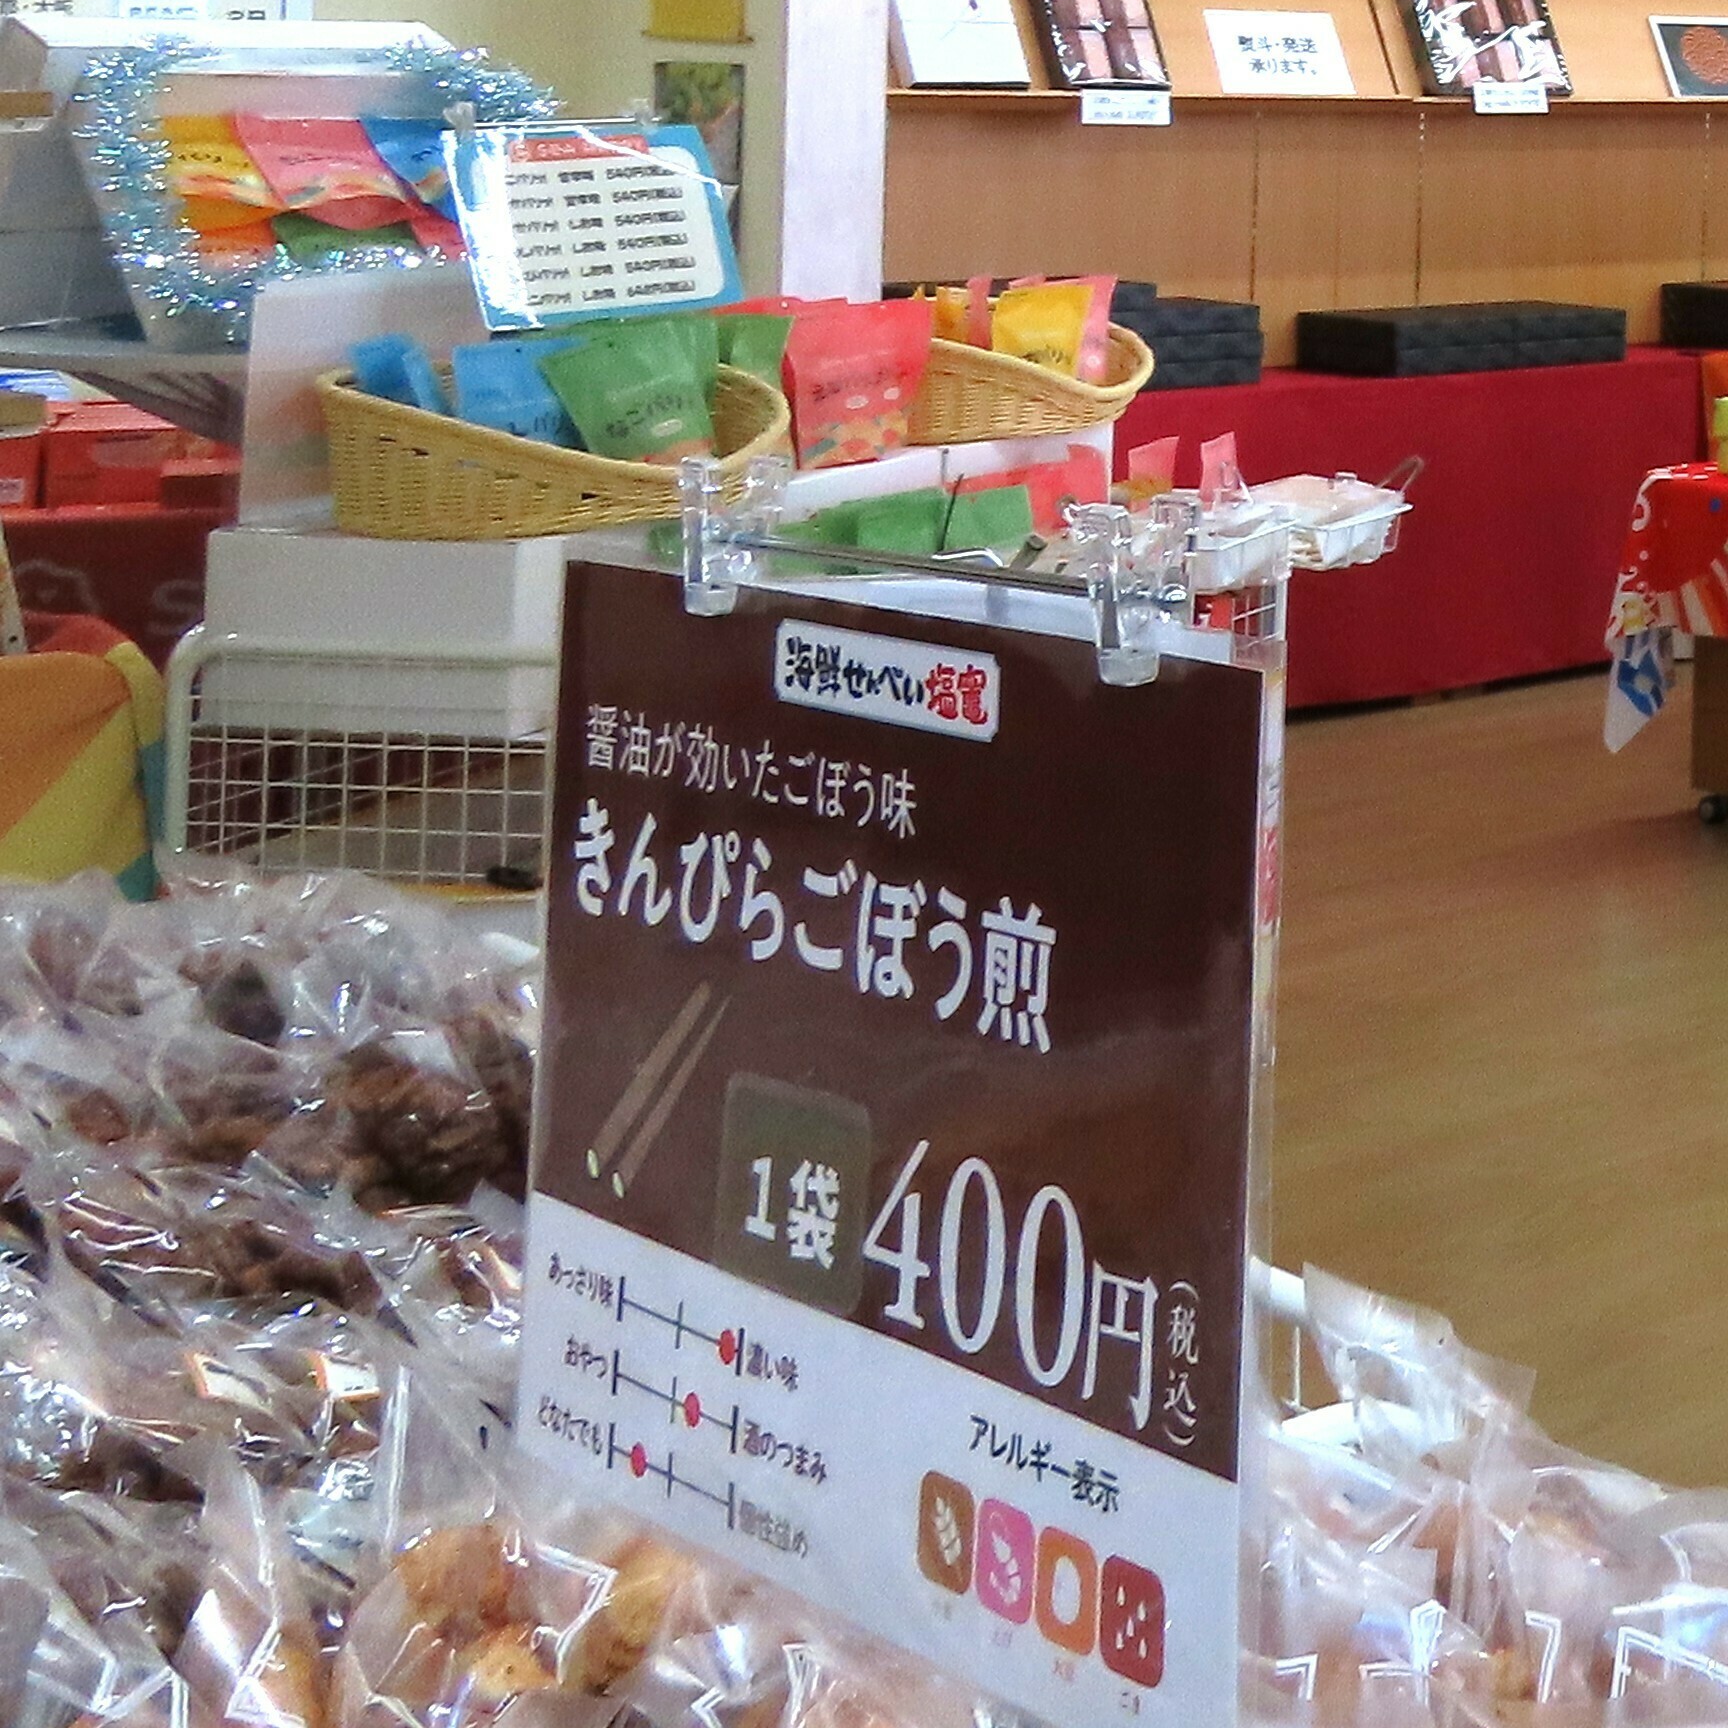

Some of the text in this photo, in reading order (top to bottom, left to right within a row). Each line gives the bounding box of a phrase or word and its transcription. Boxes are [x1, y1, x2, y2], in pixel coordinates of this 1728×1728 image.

[784, 637, 989, 726] 海鮮せんべい塩竈
[585, 703, 918, 840] 醤油が効いたごぼう味
[572, 797, 1059, 1055] きんぴらごぼう煎
[744, 1138, 1200, 1448] 1袋 400円 (税込)
[563, 1333, 608, 1379] おやつ
[742, 1418, 828, 1485] 酒のつまみ
[968, 1415, 1121, 1514] アレルギー表示
